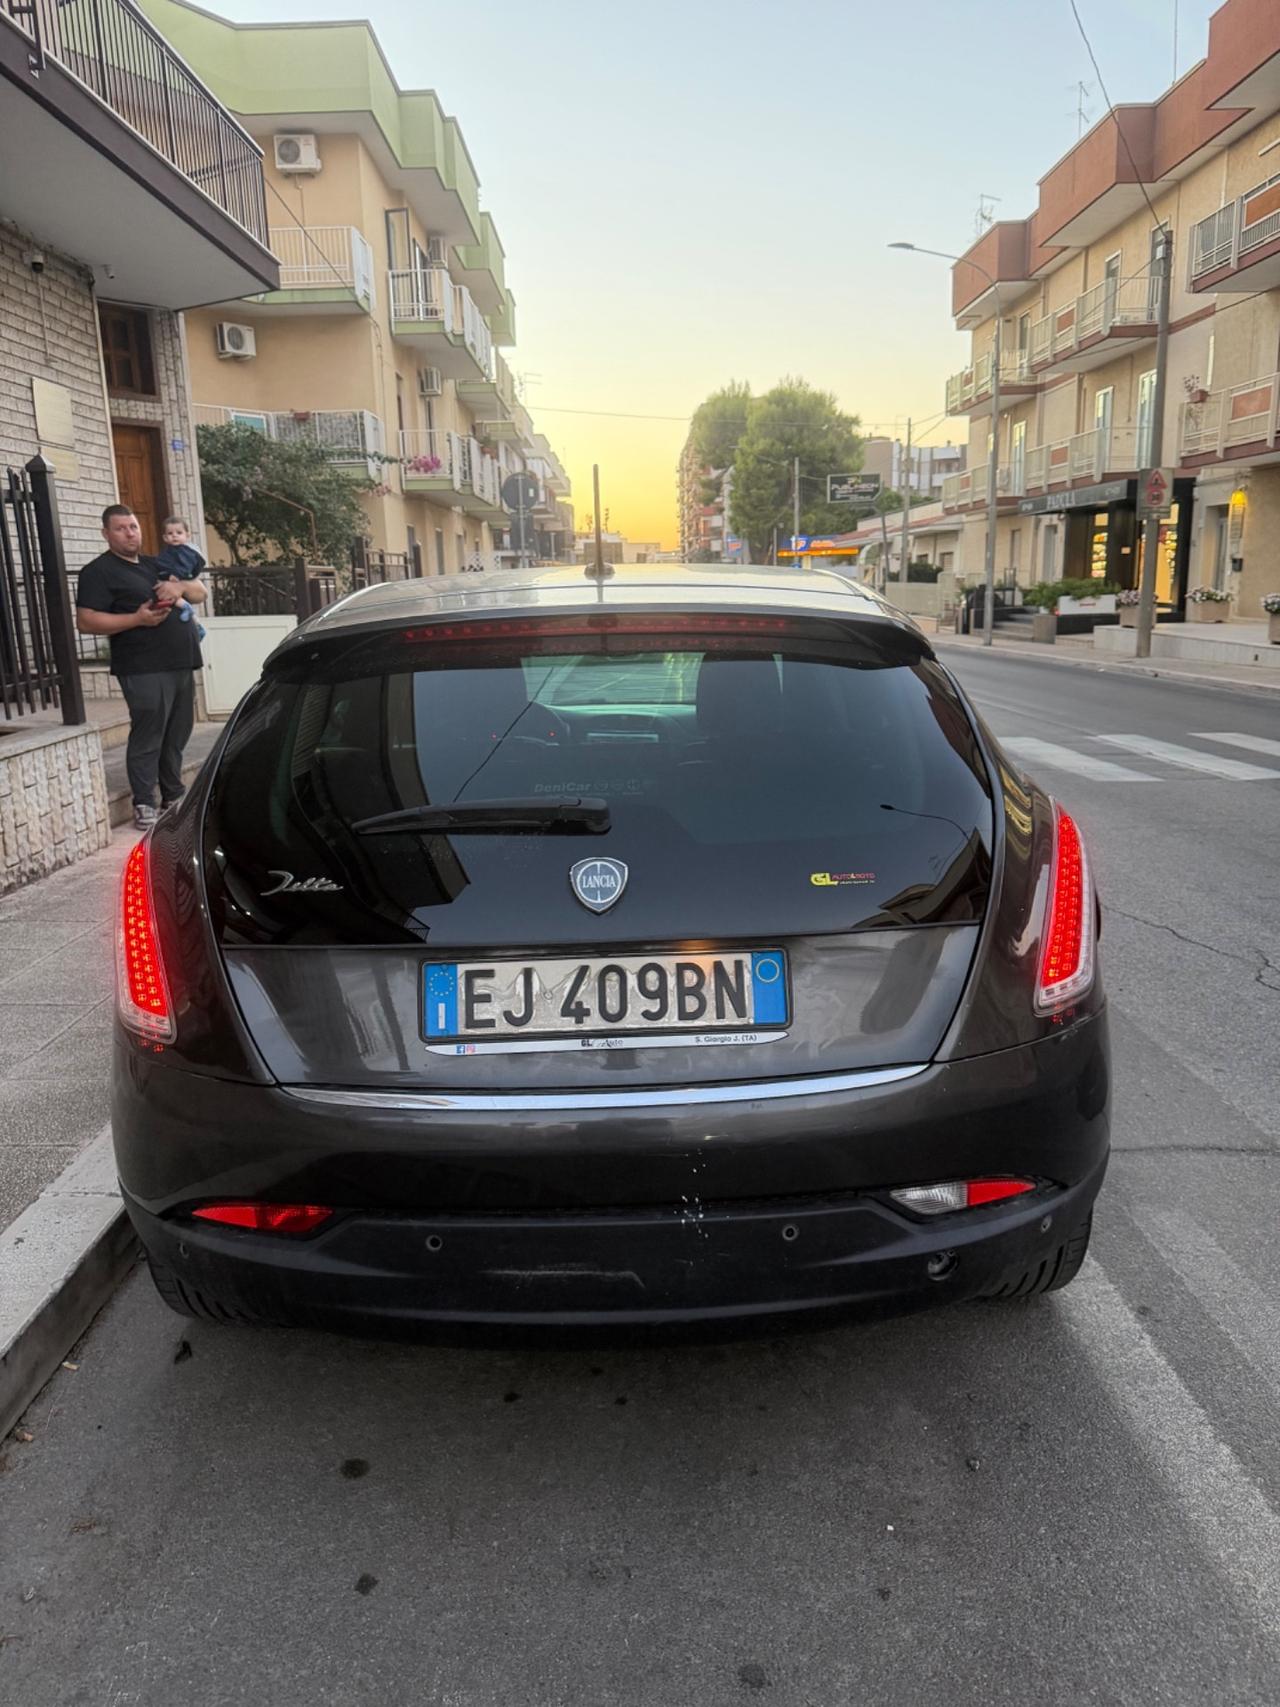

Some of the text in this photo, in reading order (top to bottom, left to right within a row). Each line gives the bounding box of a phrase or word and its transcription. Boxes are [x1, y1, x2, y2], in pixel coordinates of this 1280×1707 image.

[260, 870, 343, 896] Delta
[582, 874, 616, 888] LANCIA
[464, 960, 748, 1029] EJ 409BN
[704, 1036, 731, 1044] Giorgio
[742, 1034, 757, 1042] (TA)
